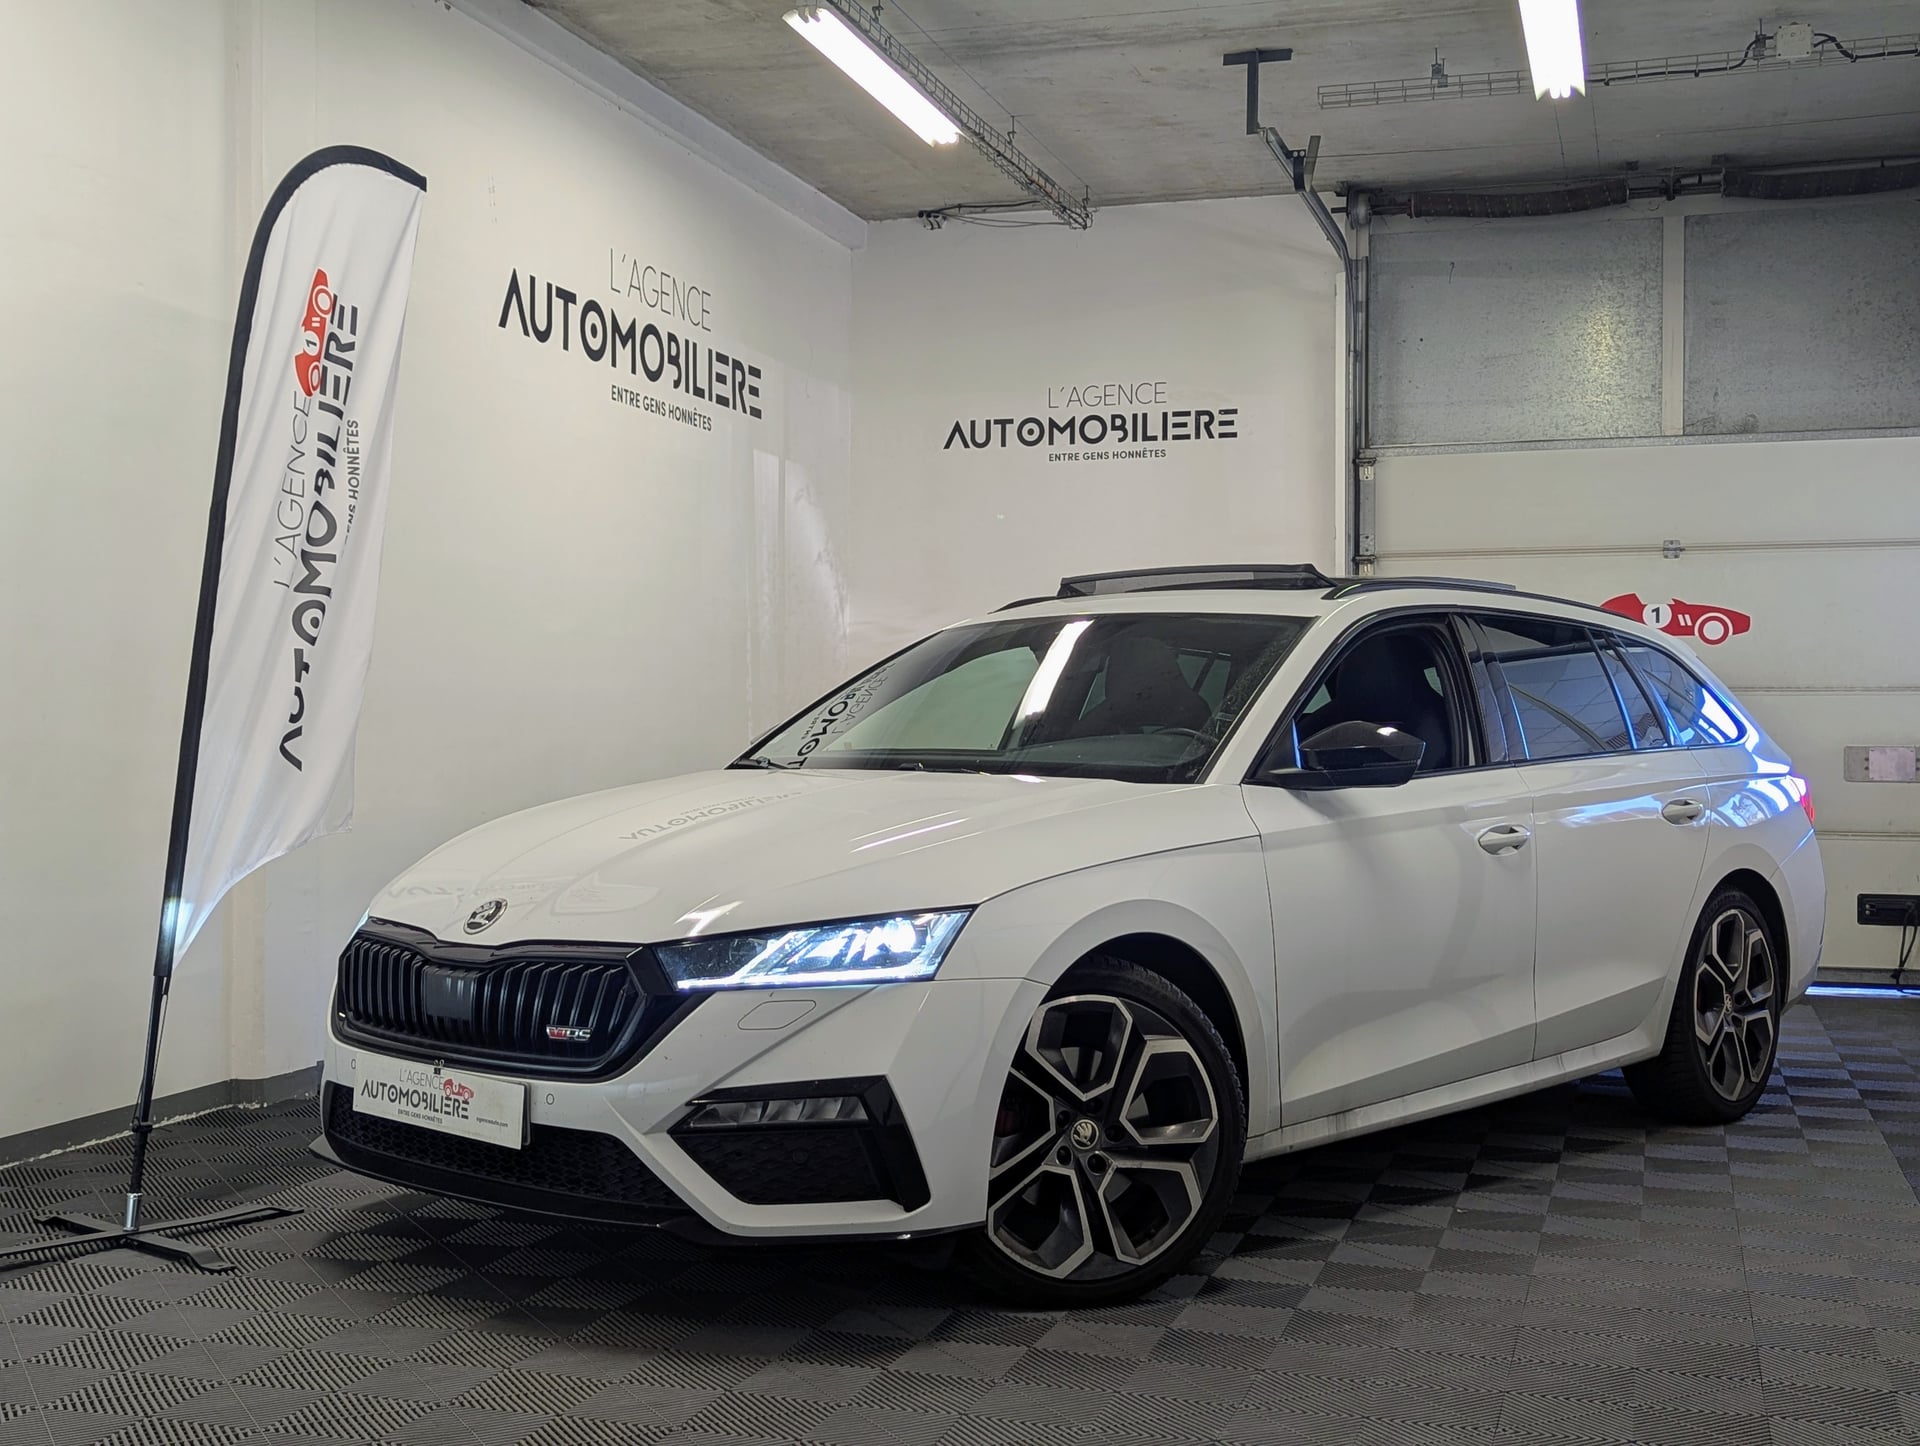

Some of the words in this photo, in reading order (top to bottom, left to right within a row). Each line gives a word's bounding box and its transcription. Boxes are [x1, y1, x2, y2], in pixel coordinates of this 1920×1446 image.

[610, 248, 711, 332] L'AGENCE
[498, 267, 762, 420] AUTOMOBILIERE
[611, 384, 641, 409] ENTRE
[643, 396, 666, 417] GENS
[668, 406, 712, 432] HONNÊTES
[1048, 382, 1167, 409] L'AGENCE
[943, 408, 1238, 450] AUTOMOBILIERE
[343, 420, 361, 500] HONNÊTES
[1049, 452, 1080, 462] ENTRE
[1083, 451, 1109, 461] GENS
[1112, 447, 1166, 460] HONNÊTES
[1650, 607, 1660, 623] 1
[361, 1079, 470, 1120] AUTOMOBILIERE
[400, 1068, 446, 1091] L'AGENCE
